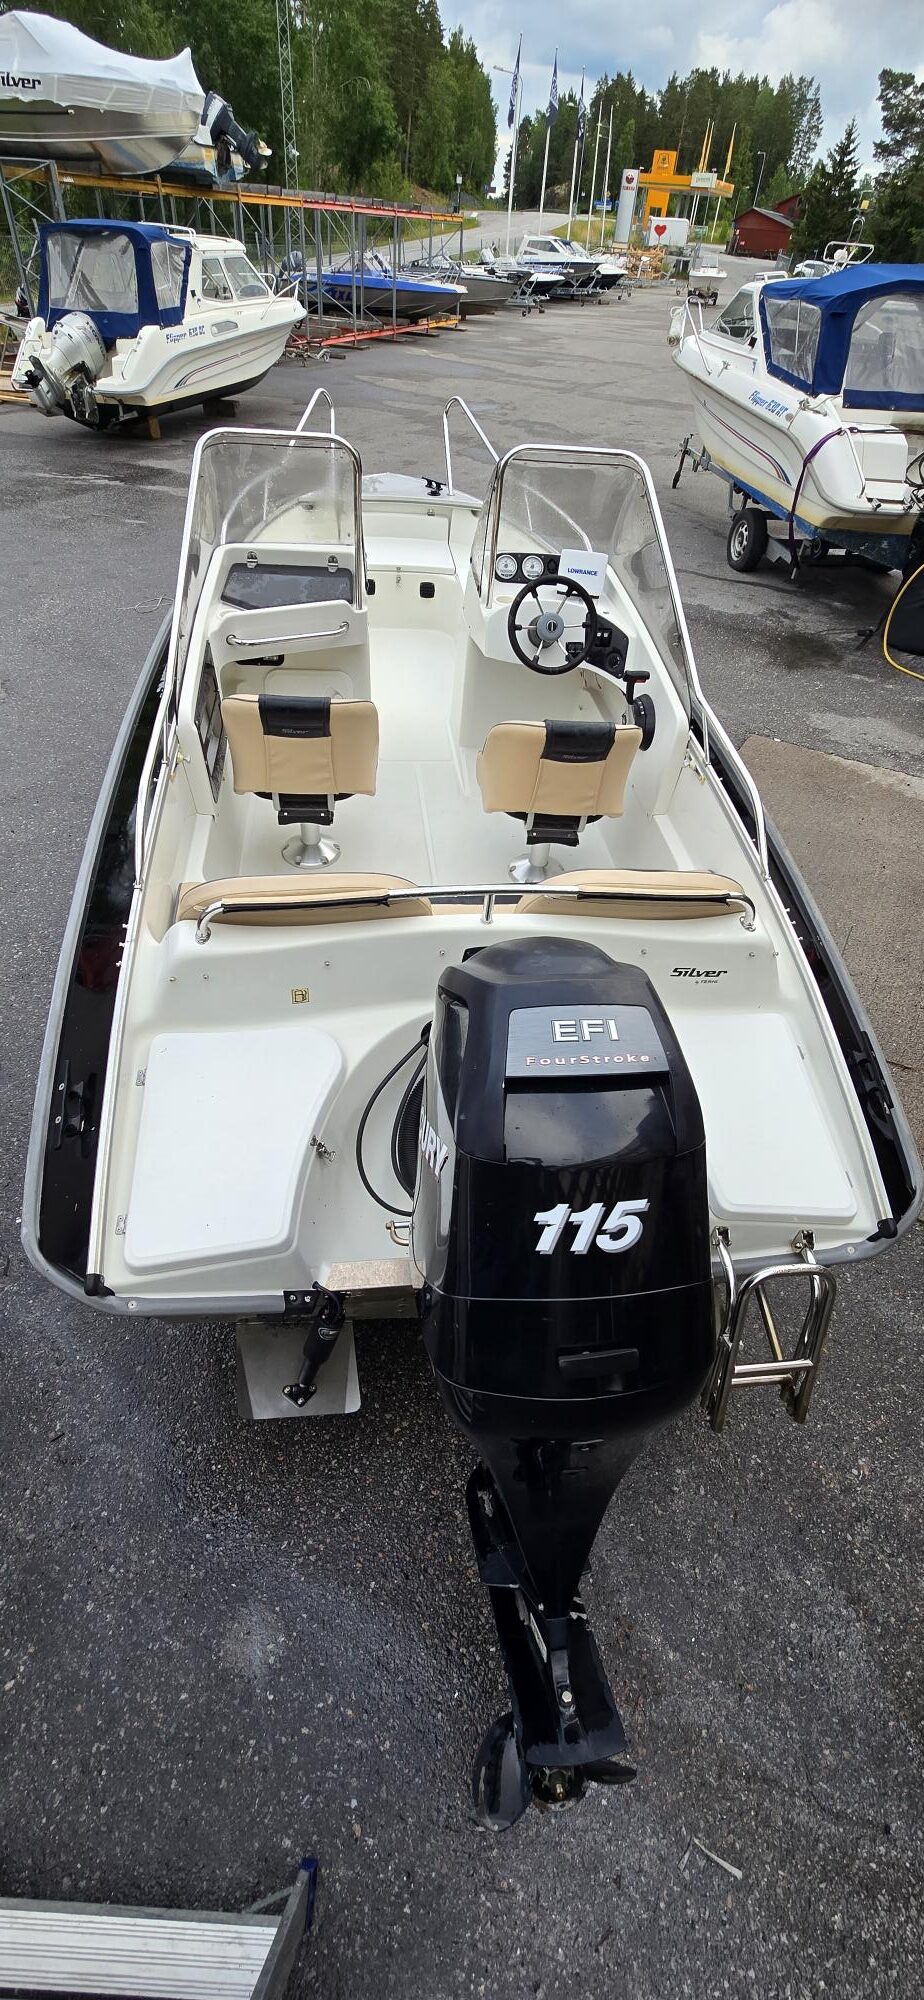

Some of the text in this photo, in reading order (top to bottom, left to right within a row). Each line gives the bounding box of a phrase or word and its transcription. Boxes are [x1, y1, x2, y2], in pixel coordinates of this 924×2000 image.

[0, 72, 41, 89] ilver
[749, 390, 768, 407] Flipper
[765, 399, 781, 413] 630
[567, 567, 598, 577] LOWRANCE
[670, 967, 728, 978] Silver
[551, 1019, 619, 1042] EFI
[525, 1053, 651, 1066] FourStroke
[533, 1198, 651, 1255] 115
